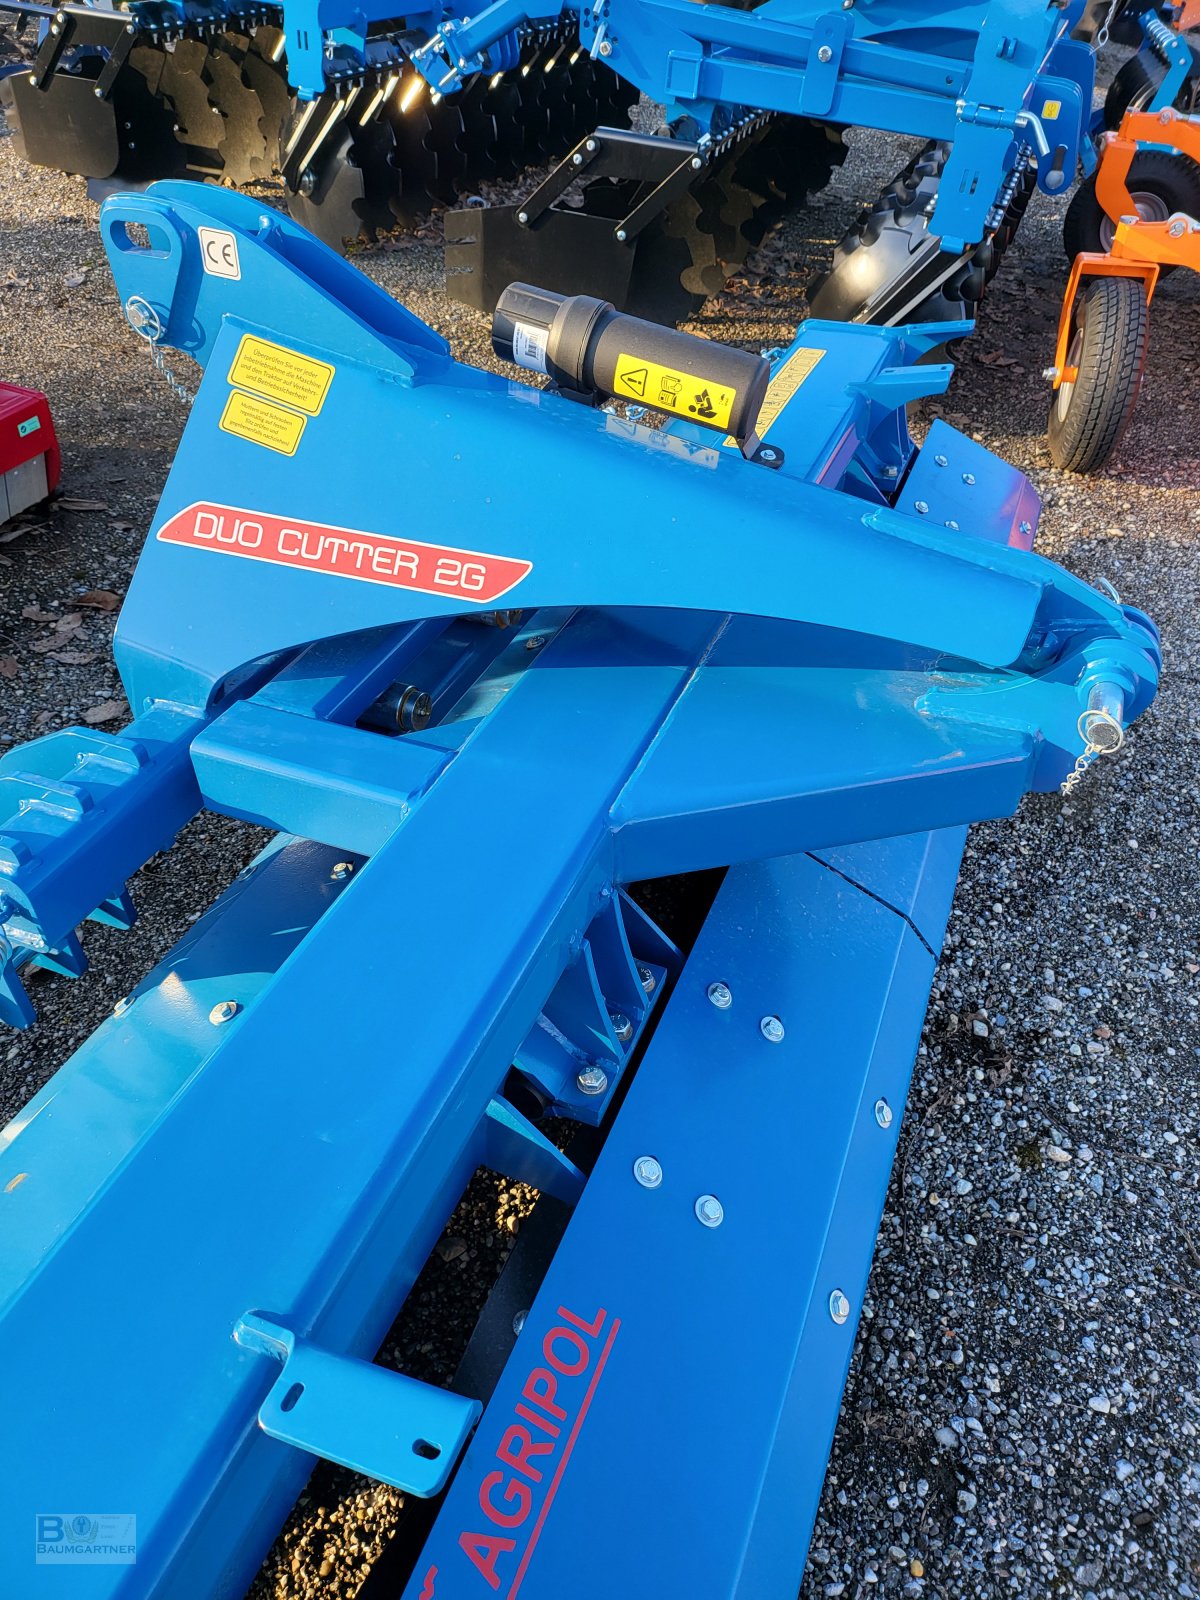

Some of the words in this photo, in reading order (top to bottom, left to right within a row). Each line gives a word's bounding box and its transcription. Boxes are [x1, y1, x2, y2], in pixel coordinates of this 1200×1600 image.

[206, 240, 234, 267] CE
[253, 348, 285, 366] Überprüfen
[303, 368, 318, 378] jeder
[257, 377, 307, 401] Betriebssicherheit!
[263, 370, 282, 382] Traktor
[292, 382, 318, 396] Verkehrs-
[296, 375, 321, 388] Maschine
[241, 402, 259, 412] Muttern
[270, 413, 292, 425] Schrauben
[254, 422, 269, 431] prüfen
[273, 422, 287, 431] festen
[193, 511, 263, 548] DUO
[277, 528, 419, 579] CUTTER
[434, 558, 486, 591] 2G
[458, 1305, 607, 1591] AGRIPOL
